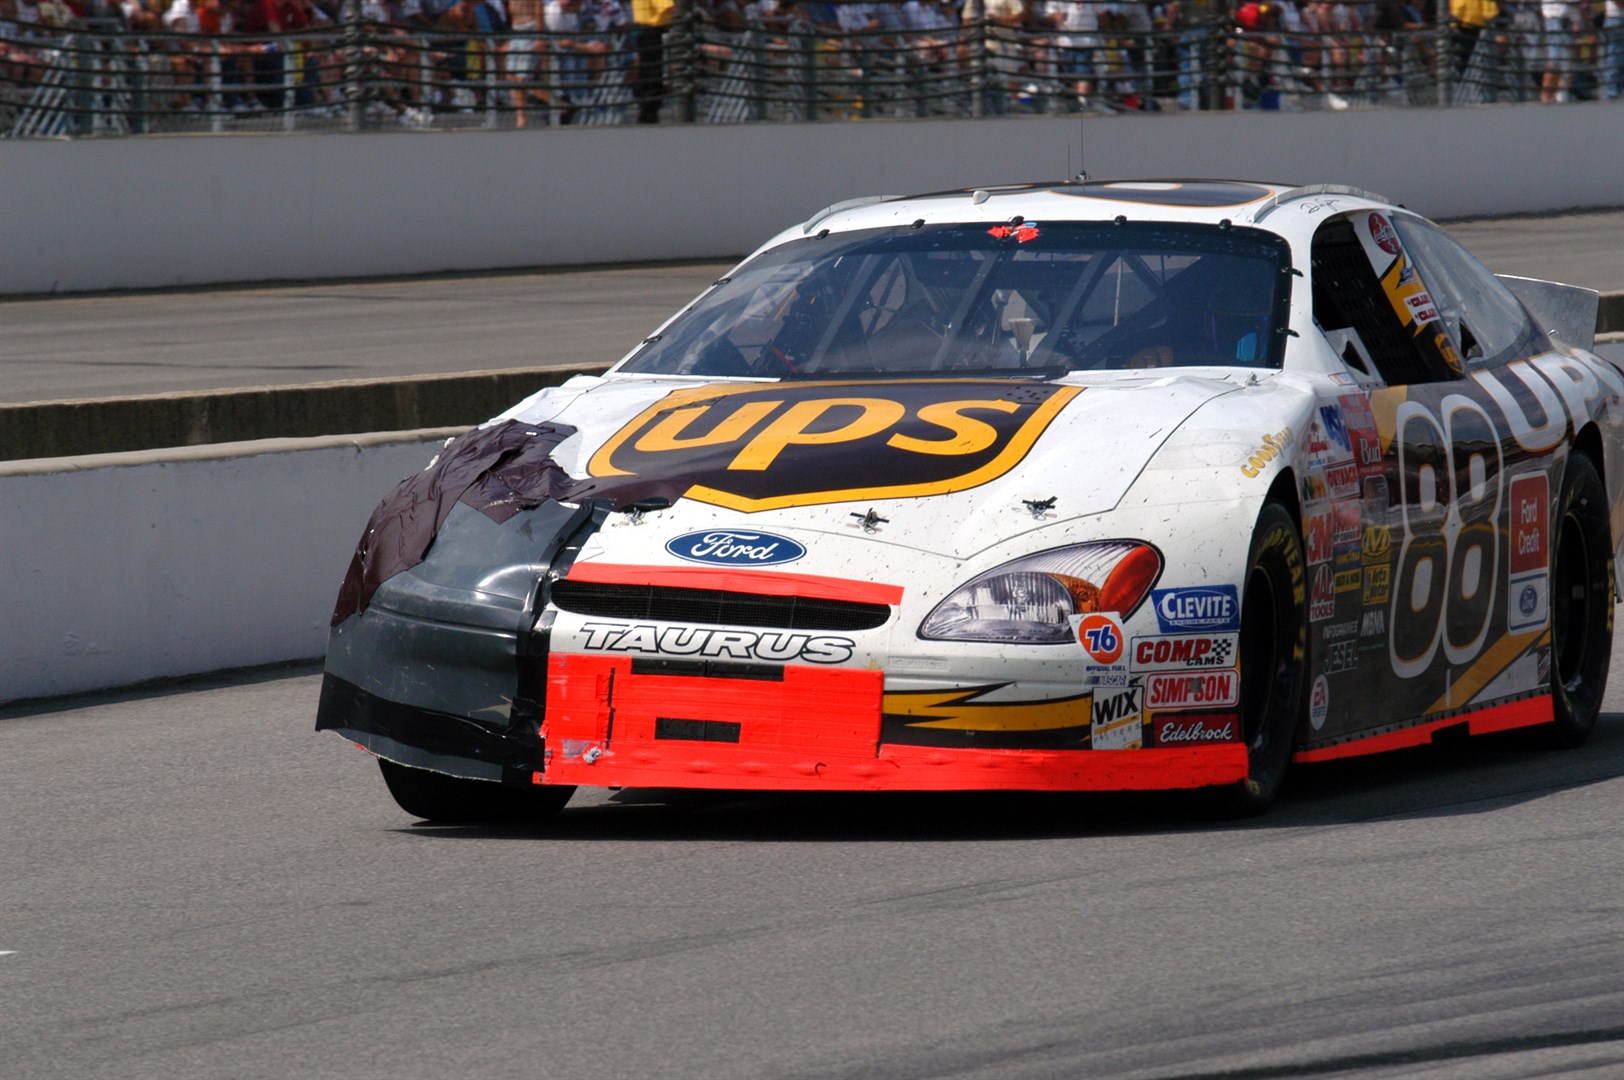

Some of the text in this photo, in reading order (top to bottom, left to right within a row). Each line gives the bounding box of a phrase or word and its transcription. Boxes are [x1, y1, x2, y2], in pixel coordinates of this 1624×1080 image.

[1359, 437, 1382, 464] Bud
[1520, 498, 1537, 525] Ford
[690, 532, 779, 560] Ford
[1390, 394, 1503, 679] 88
[1518, 529, 1540, 556] Credit
[1162, 592, 1232, 619] CLEVITE
[1311, 604, 1334, 619] TOOLS
[581, 622, 856, 664] TAURUS
[1085, 624, 1118, 653] 76
[1136, 638, 1212, 665] COMP
[1186, 656, 1225, 667] CAMS
[1151, 675, 1231, 704] SIMPSON
[1095, 689, 1139, 726] WIX
[1160, 722, 1233, 743] Edelbrock
